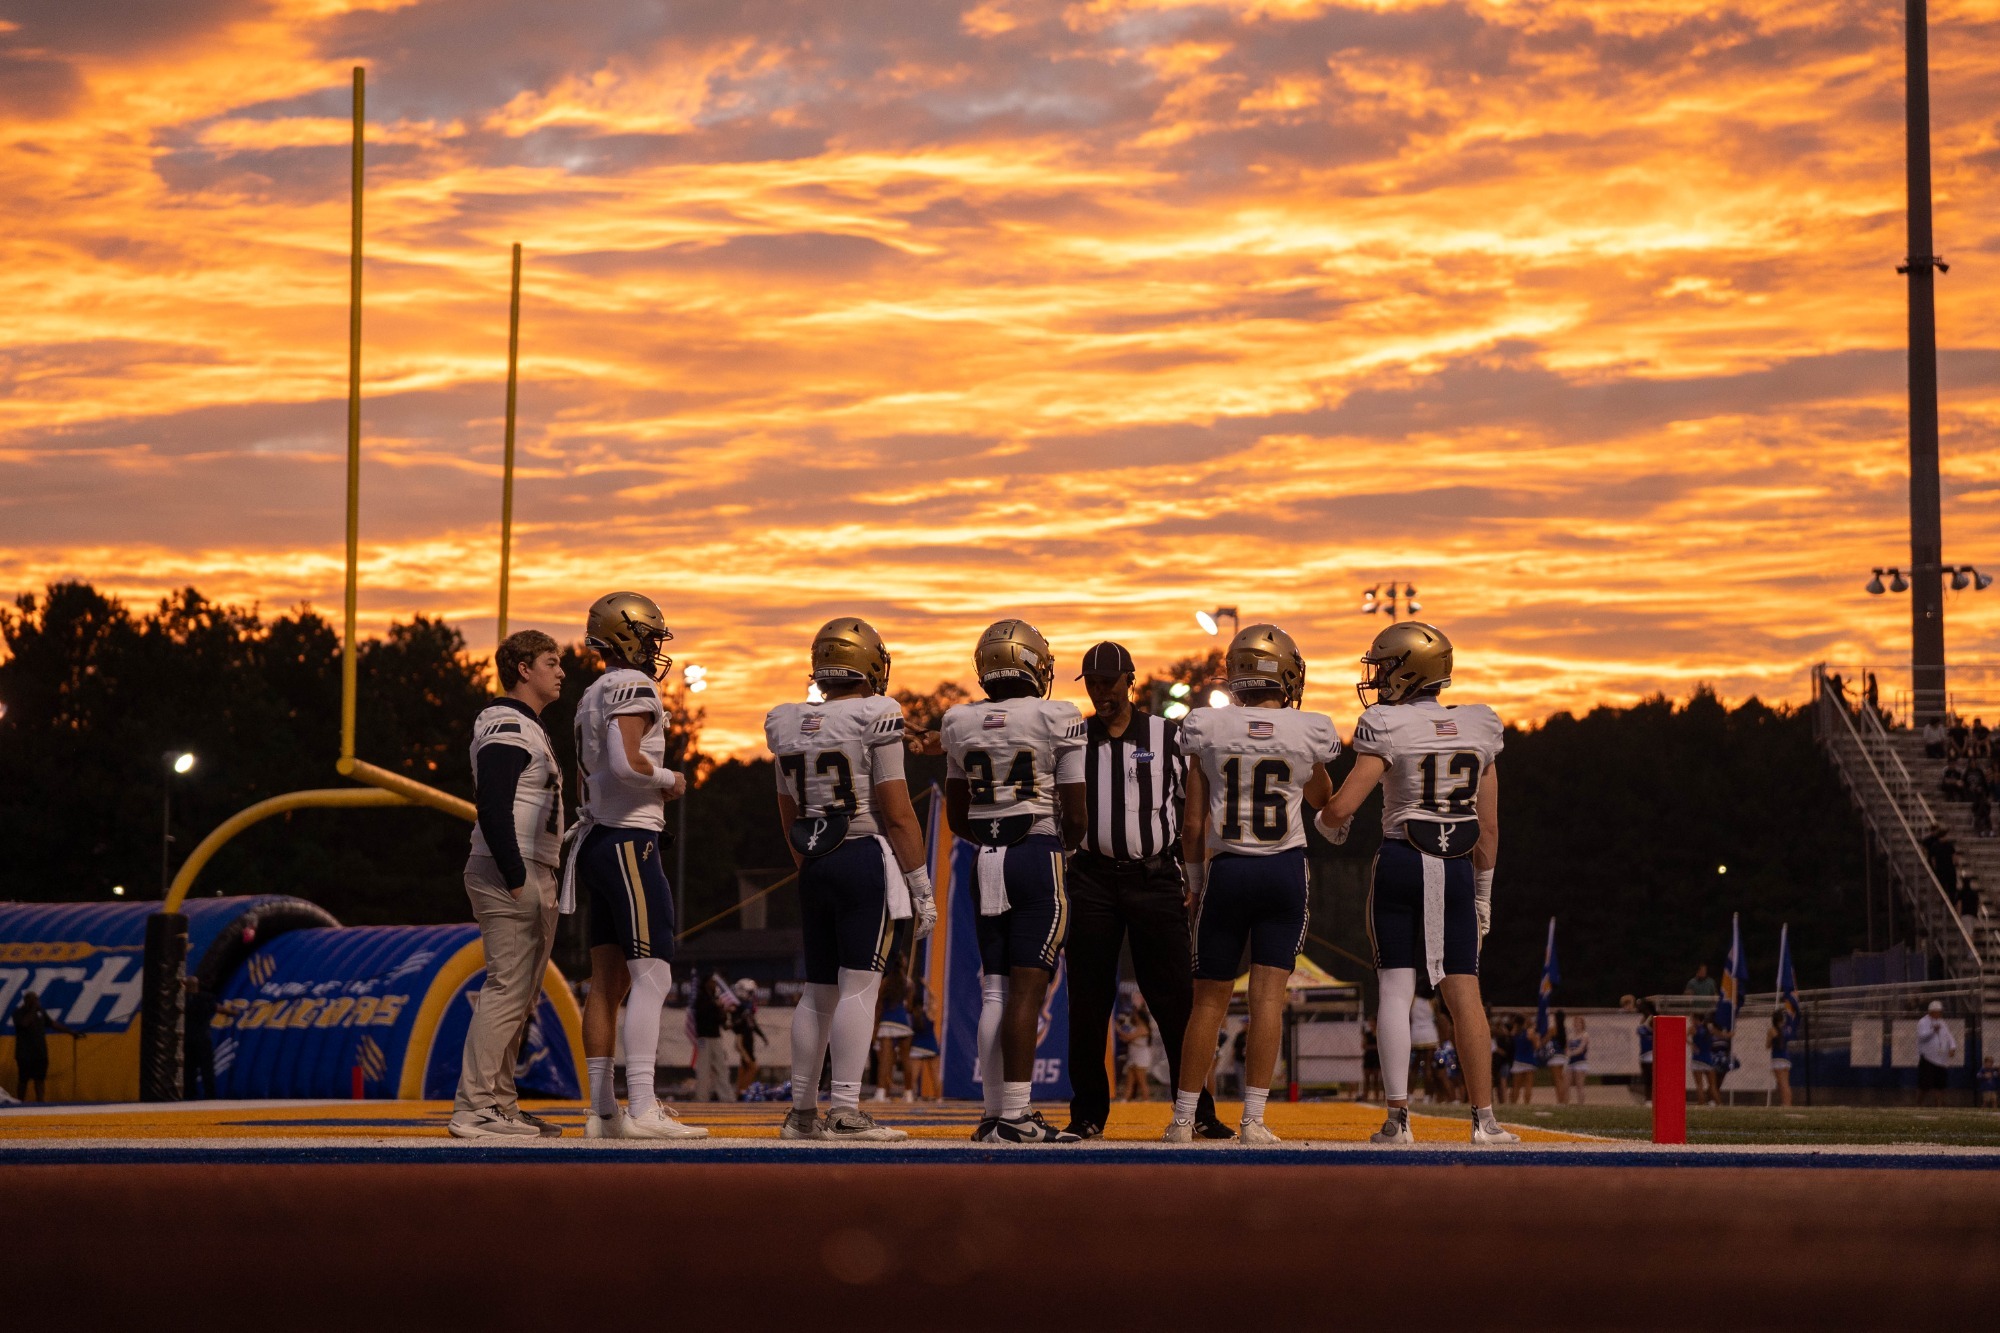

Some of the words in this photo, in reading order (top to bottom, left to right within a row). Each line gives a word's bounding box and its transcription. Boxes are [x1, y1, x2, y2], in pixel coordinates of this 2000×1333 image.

[779, 750, 858, 818] 73
[963, 749, 1038, 806] 24
[1221, 755, 1292, 844] 16
[1418, 750, 1481, 816] 12
[210, 994, 410, 1030] COUGARS
